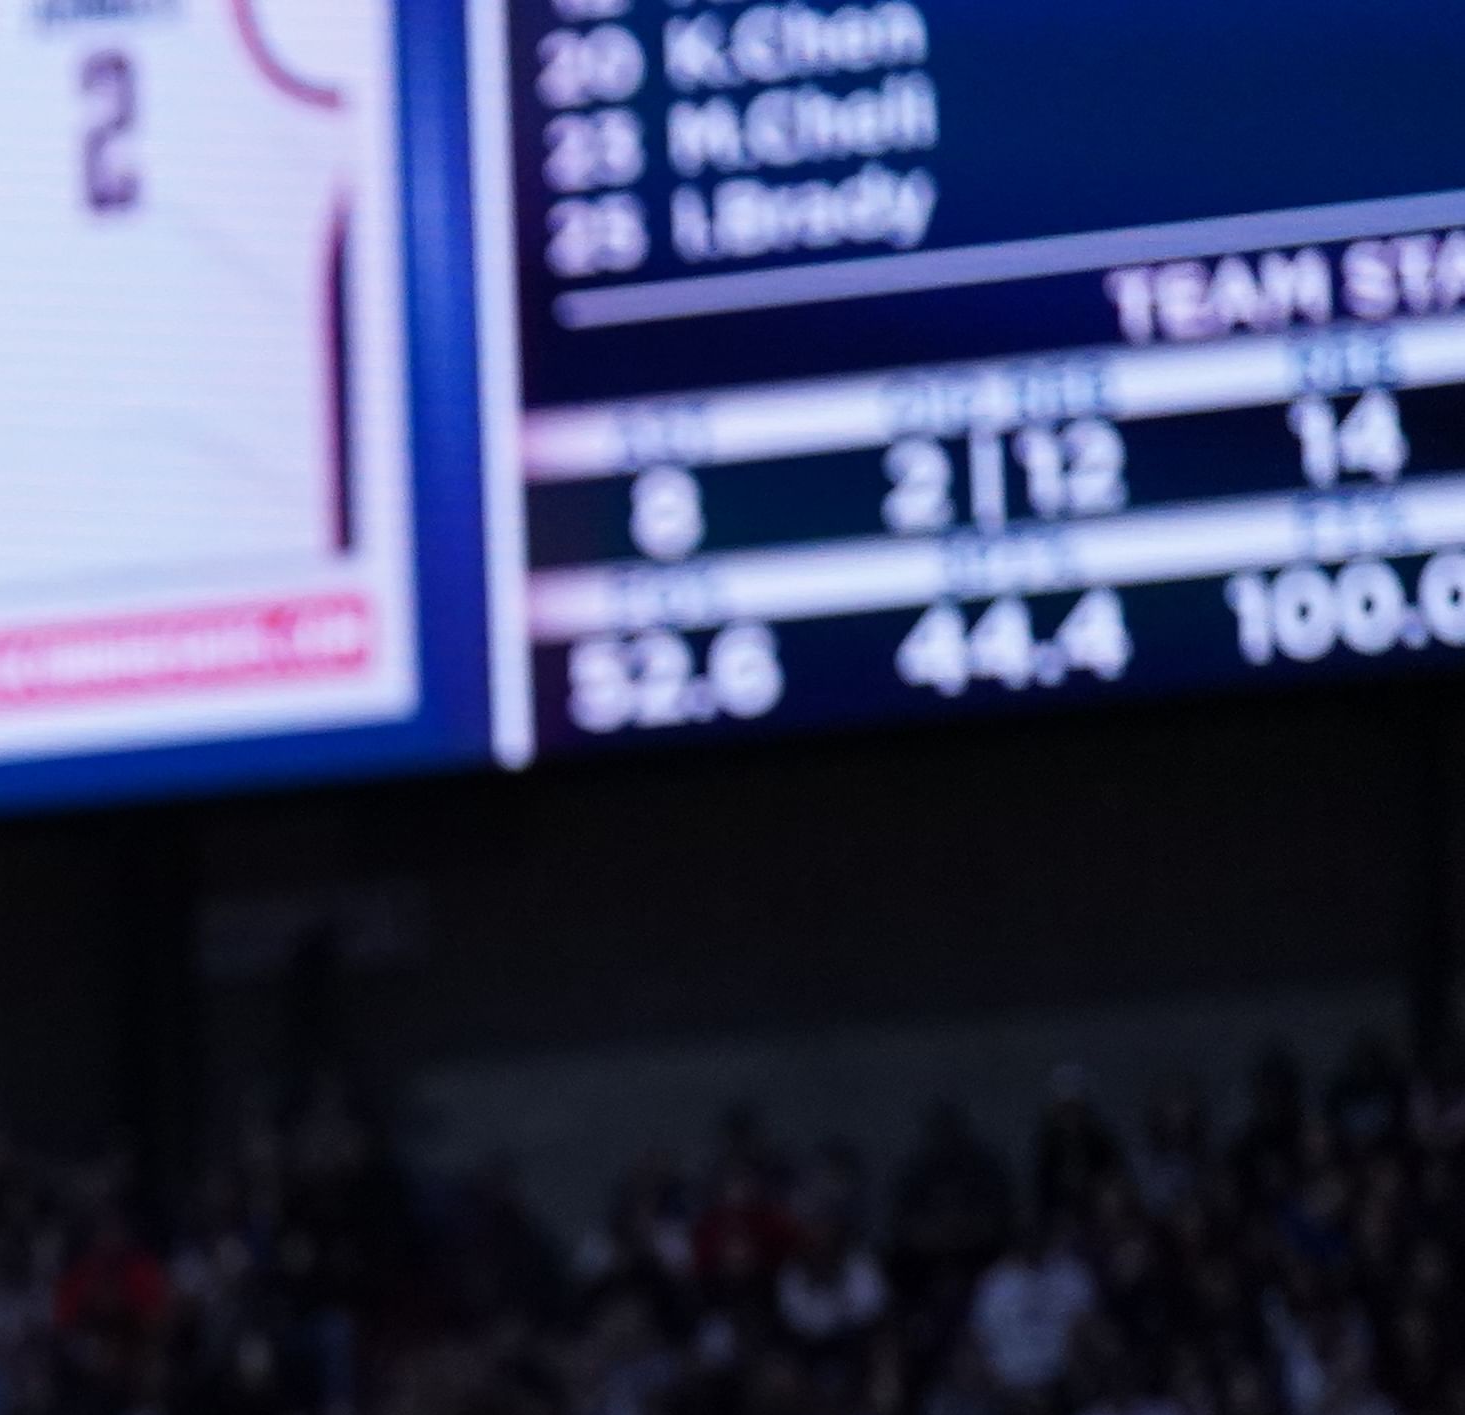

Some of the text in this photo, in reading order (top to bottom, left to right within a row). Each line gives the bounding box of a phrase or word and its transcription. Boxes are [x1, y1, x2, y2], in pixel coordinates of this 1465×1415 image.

[538, 26, 645, 108] 20
[79, 49, 140, 212] 2
[1103, 246, 1334, 344] TEAM
[1287, 387, 1410, 491] 14
[897, 590, 1132, 698] 44.4
[1224, 551, 1465, 666] 100.0
